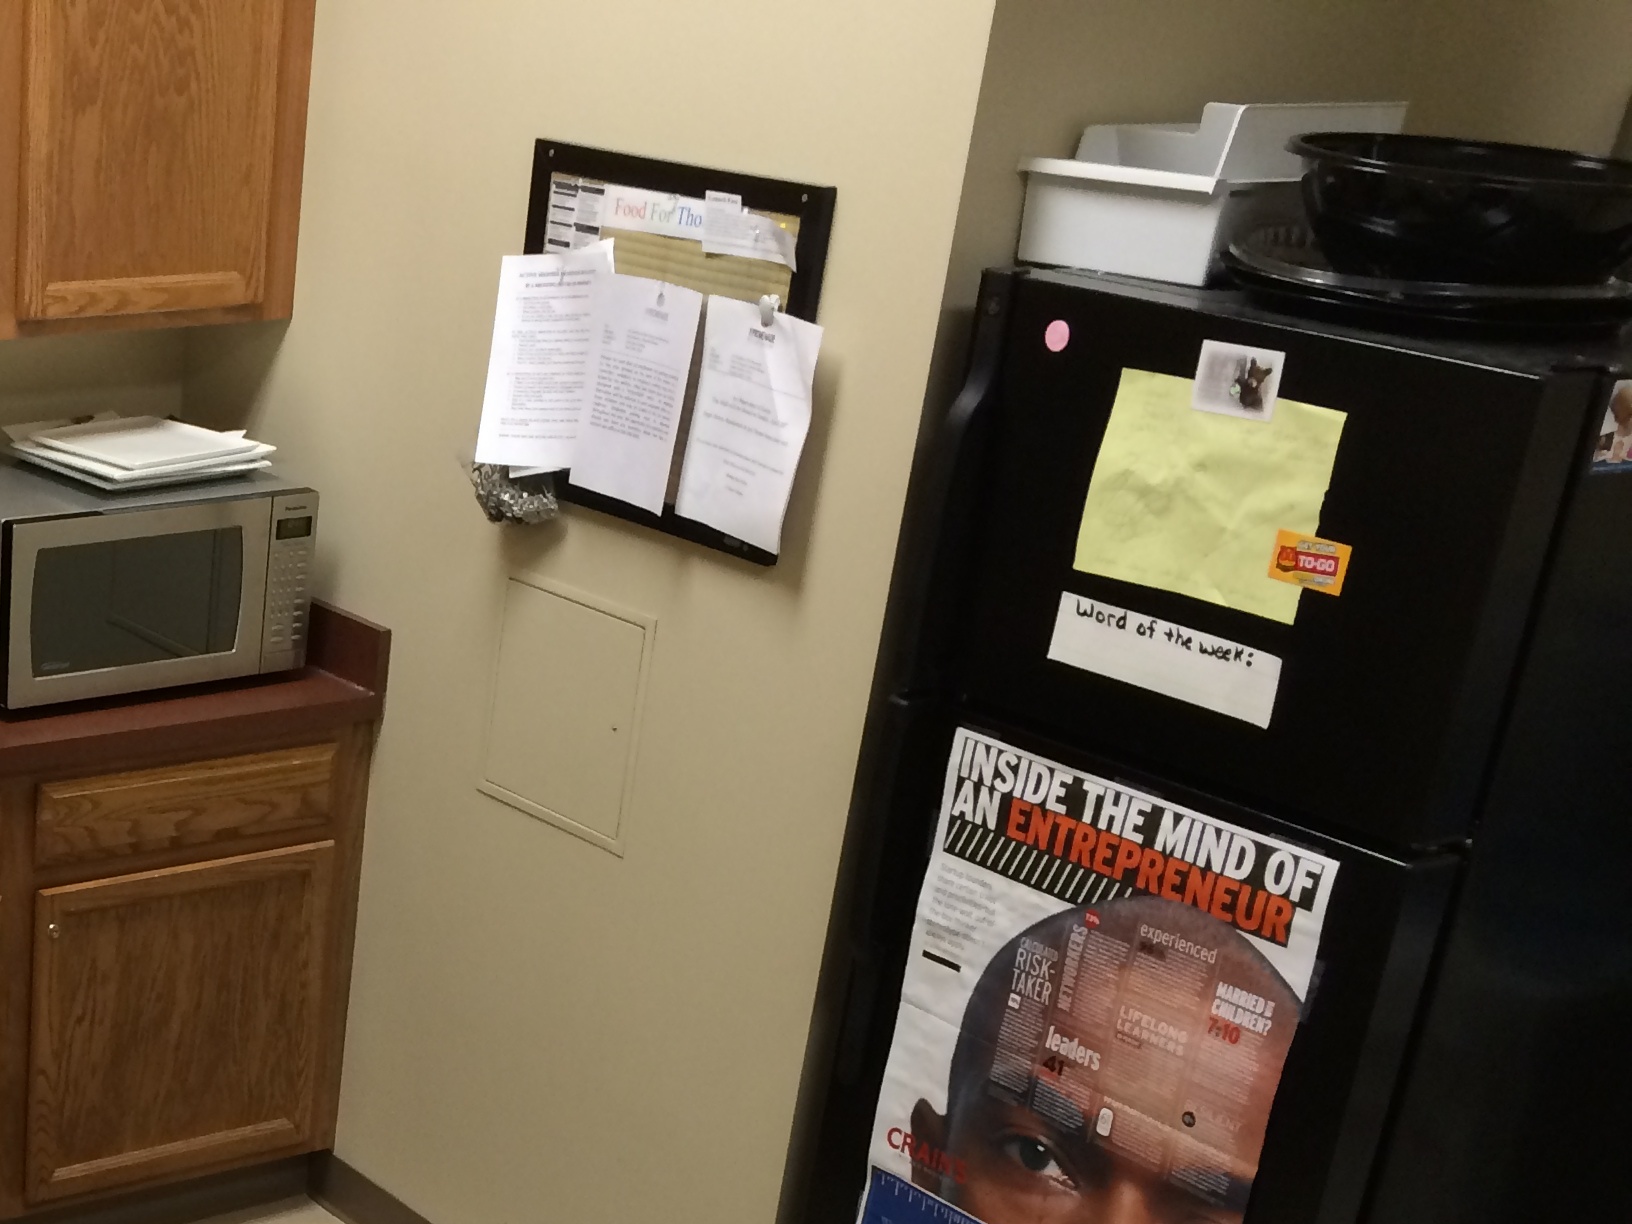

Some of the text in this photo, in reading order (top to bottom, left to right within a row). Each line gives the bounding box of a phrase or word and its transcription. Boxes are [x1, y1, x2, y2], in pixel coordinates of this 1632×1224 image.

[614, 198, 703, 228] Food For Tho
[1297, 555, 1335, 572] TO-GO
[1076, 599, 1254, 667] Word of the week:
[960, 739, 1323, 902] INSIDE THE MIND OF
[951, 780, 1002, 831] AN
[1006, 798, 1296, 943] ENTREPRENEUR
[1140, 924, 1218, 964] experienced
[1015, 947, 1055, 981] RISK-
[1056, 924, 1088, 1012] NETWORKERS
[1011, 968, 1052, 1006] TAKER
[1215, 981, 1266, 1014] MARRIED
[1119, 1005, 1188, 1044] LIFELONG
[1211, 998, 1272, 1036] CHILDREN?
[1045, 1025, 1101, 1071] leaders
[1117, 1018, 1185, 1057] LEARNERS
